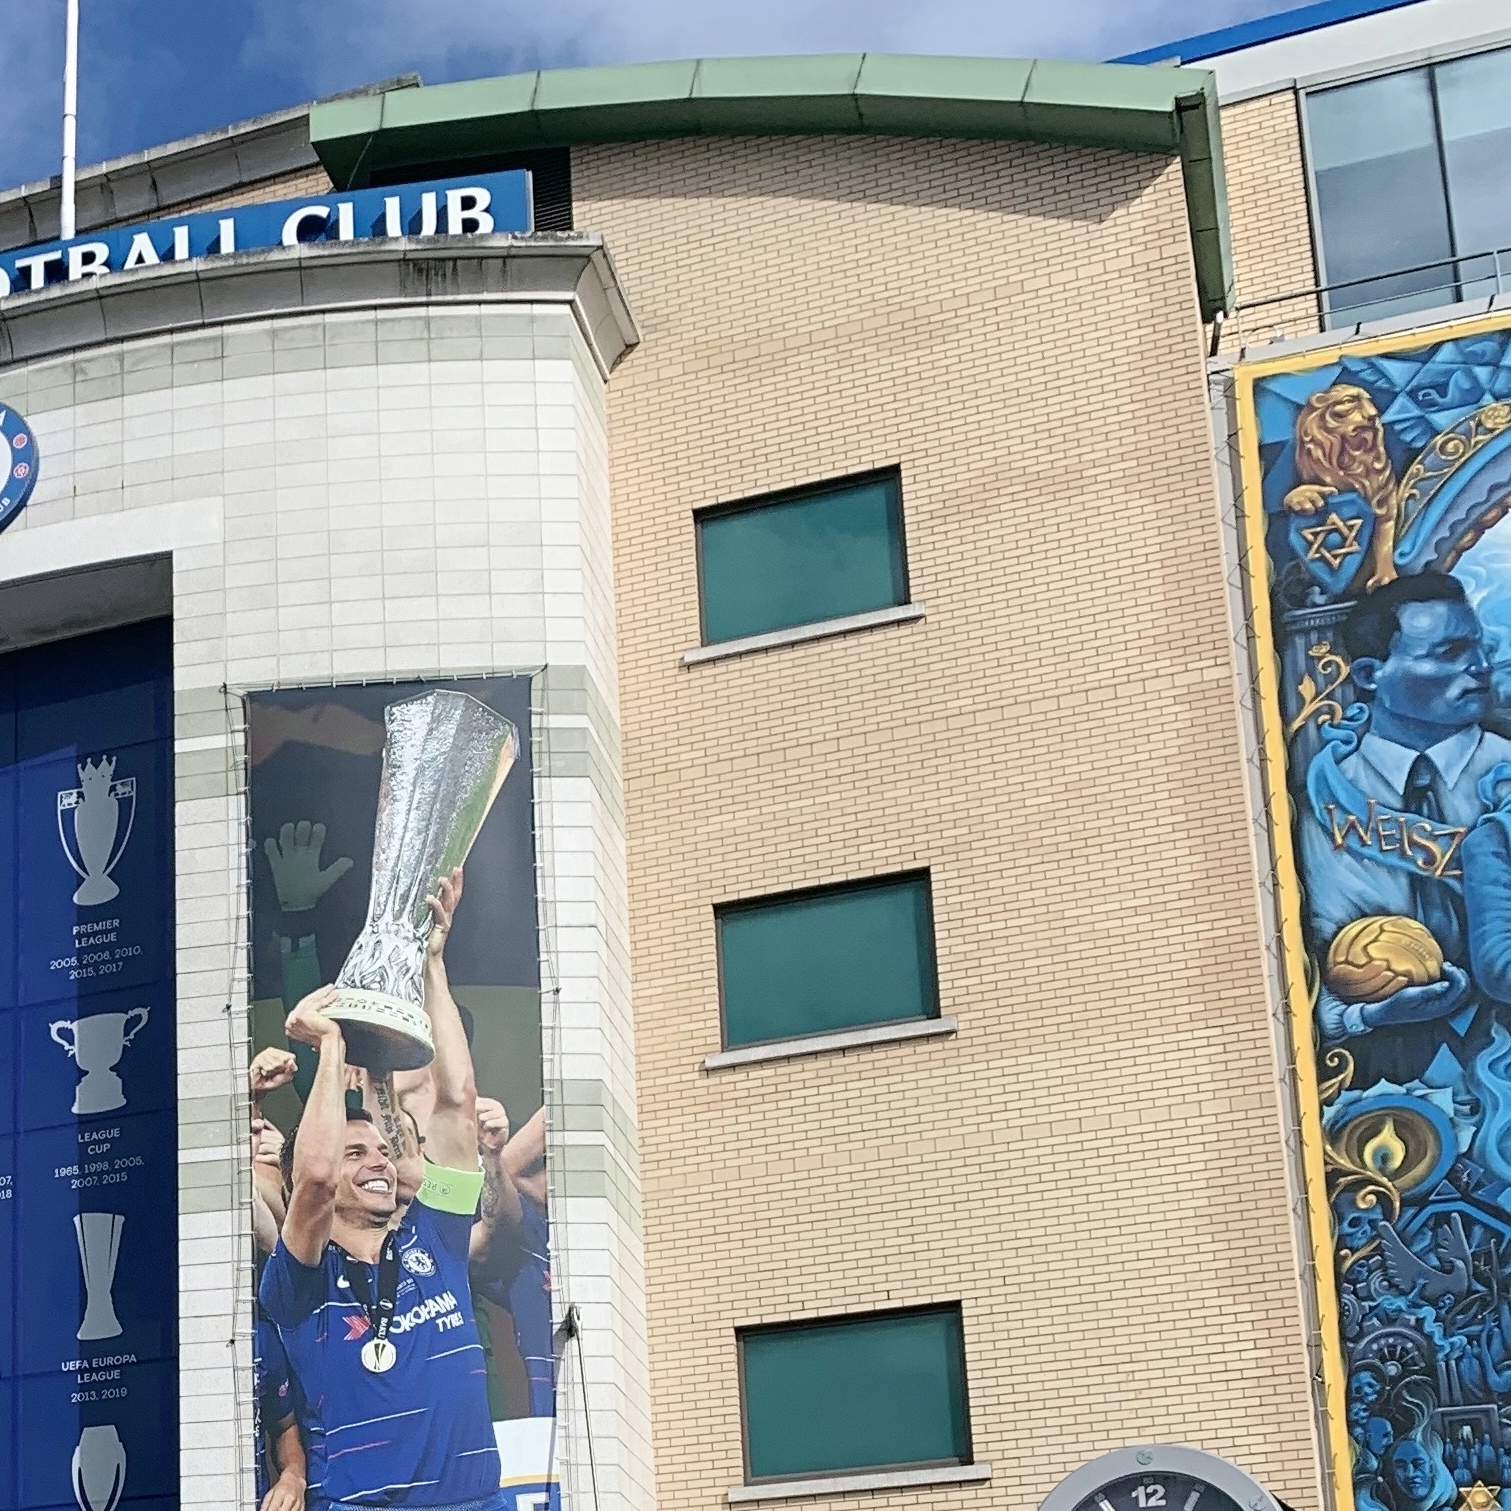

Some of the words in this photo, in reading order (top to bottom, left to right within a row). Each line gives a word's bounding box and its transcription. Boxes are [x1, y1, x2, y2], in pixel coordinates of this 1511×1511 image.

[1325, 799, 1467, 879] WEISZ
[72, 919, 120, 935] PREMIER
[75, 932, 117, 948] LEAGUE
[99, 962, 123, 976] 2017
[78, 1127, 121, 1143] LEAGUE
[87, 1143, 111, 1155] CUP
[102, 1172, 127, 1185] 2015
[61, 1359, 89, 1372] UEFA
[91, 1354, 137, 1369] EUROPA
[77, 1370, 121, 1384] LEAGUE
[101, 1387, 127, 1400] 2019
[1132, 1484, 1166, 1508] 12
